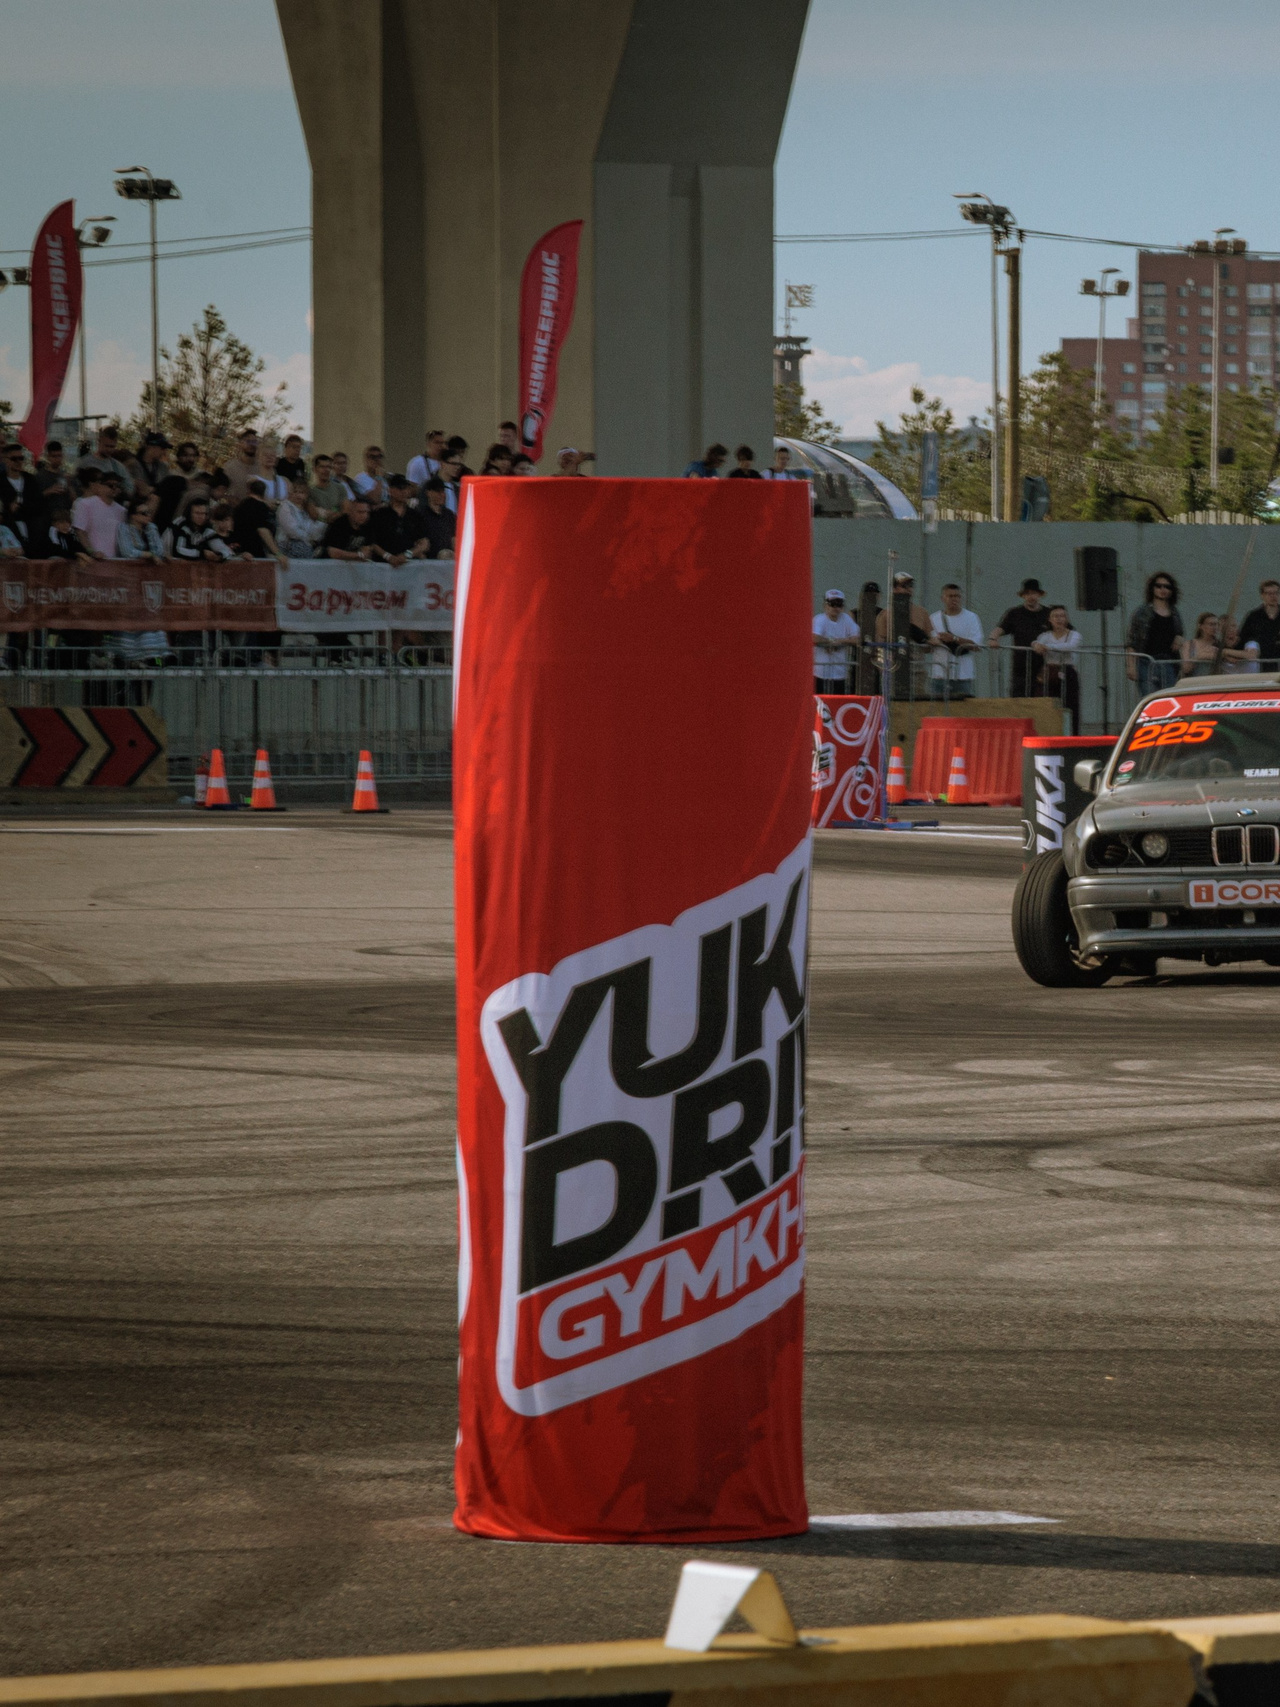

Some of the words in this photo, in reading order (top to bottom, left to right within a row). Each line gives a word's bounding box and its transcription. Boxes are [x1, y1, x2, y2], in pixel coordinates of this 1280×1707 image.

[45, 233, 72, 352] НСЕРВИС
[529, 250, 560, 404] ШИНСЕРВИС
[1127, 720, 1219, 752] 225
[1194, 701, 1231, 710] YUKA
[1233, 700, 1277, 709] DRIVE
[1034, 754, 1066, 855] UKA
[517, 1023, 805, 1296] DRI
